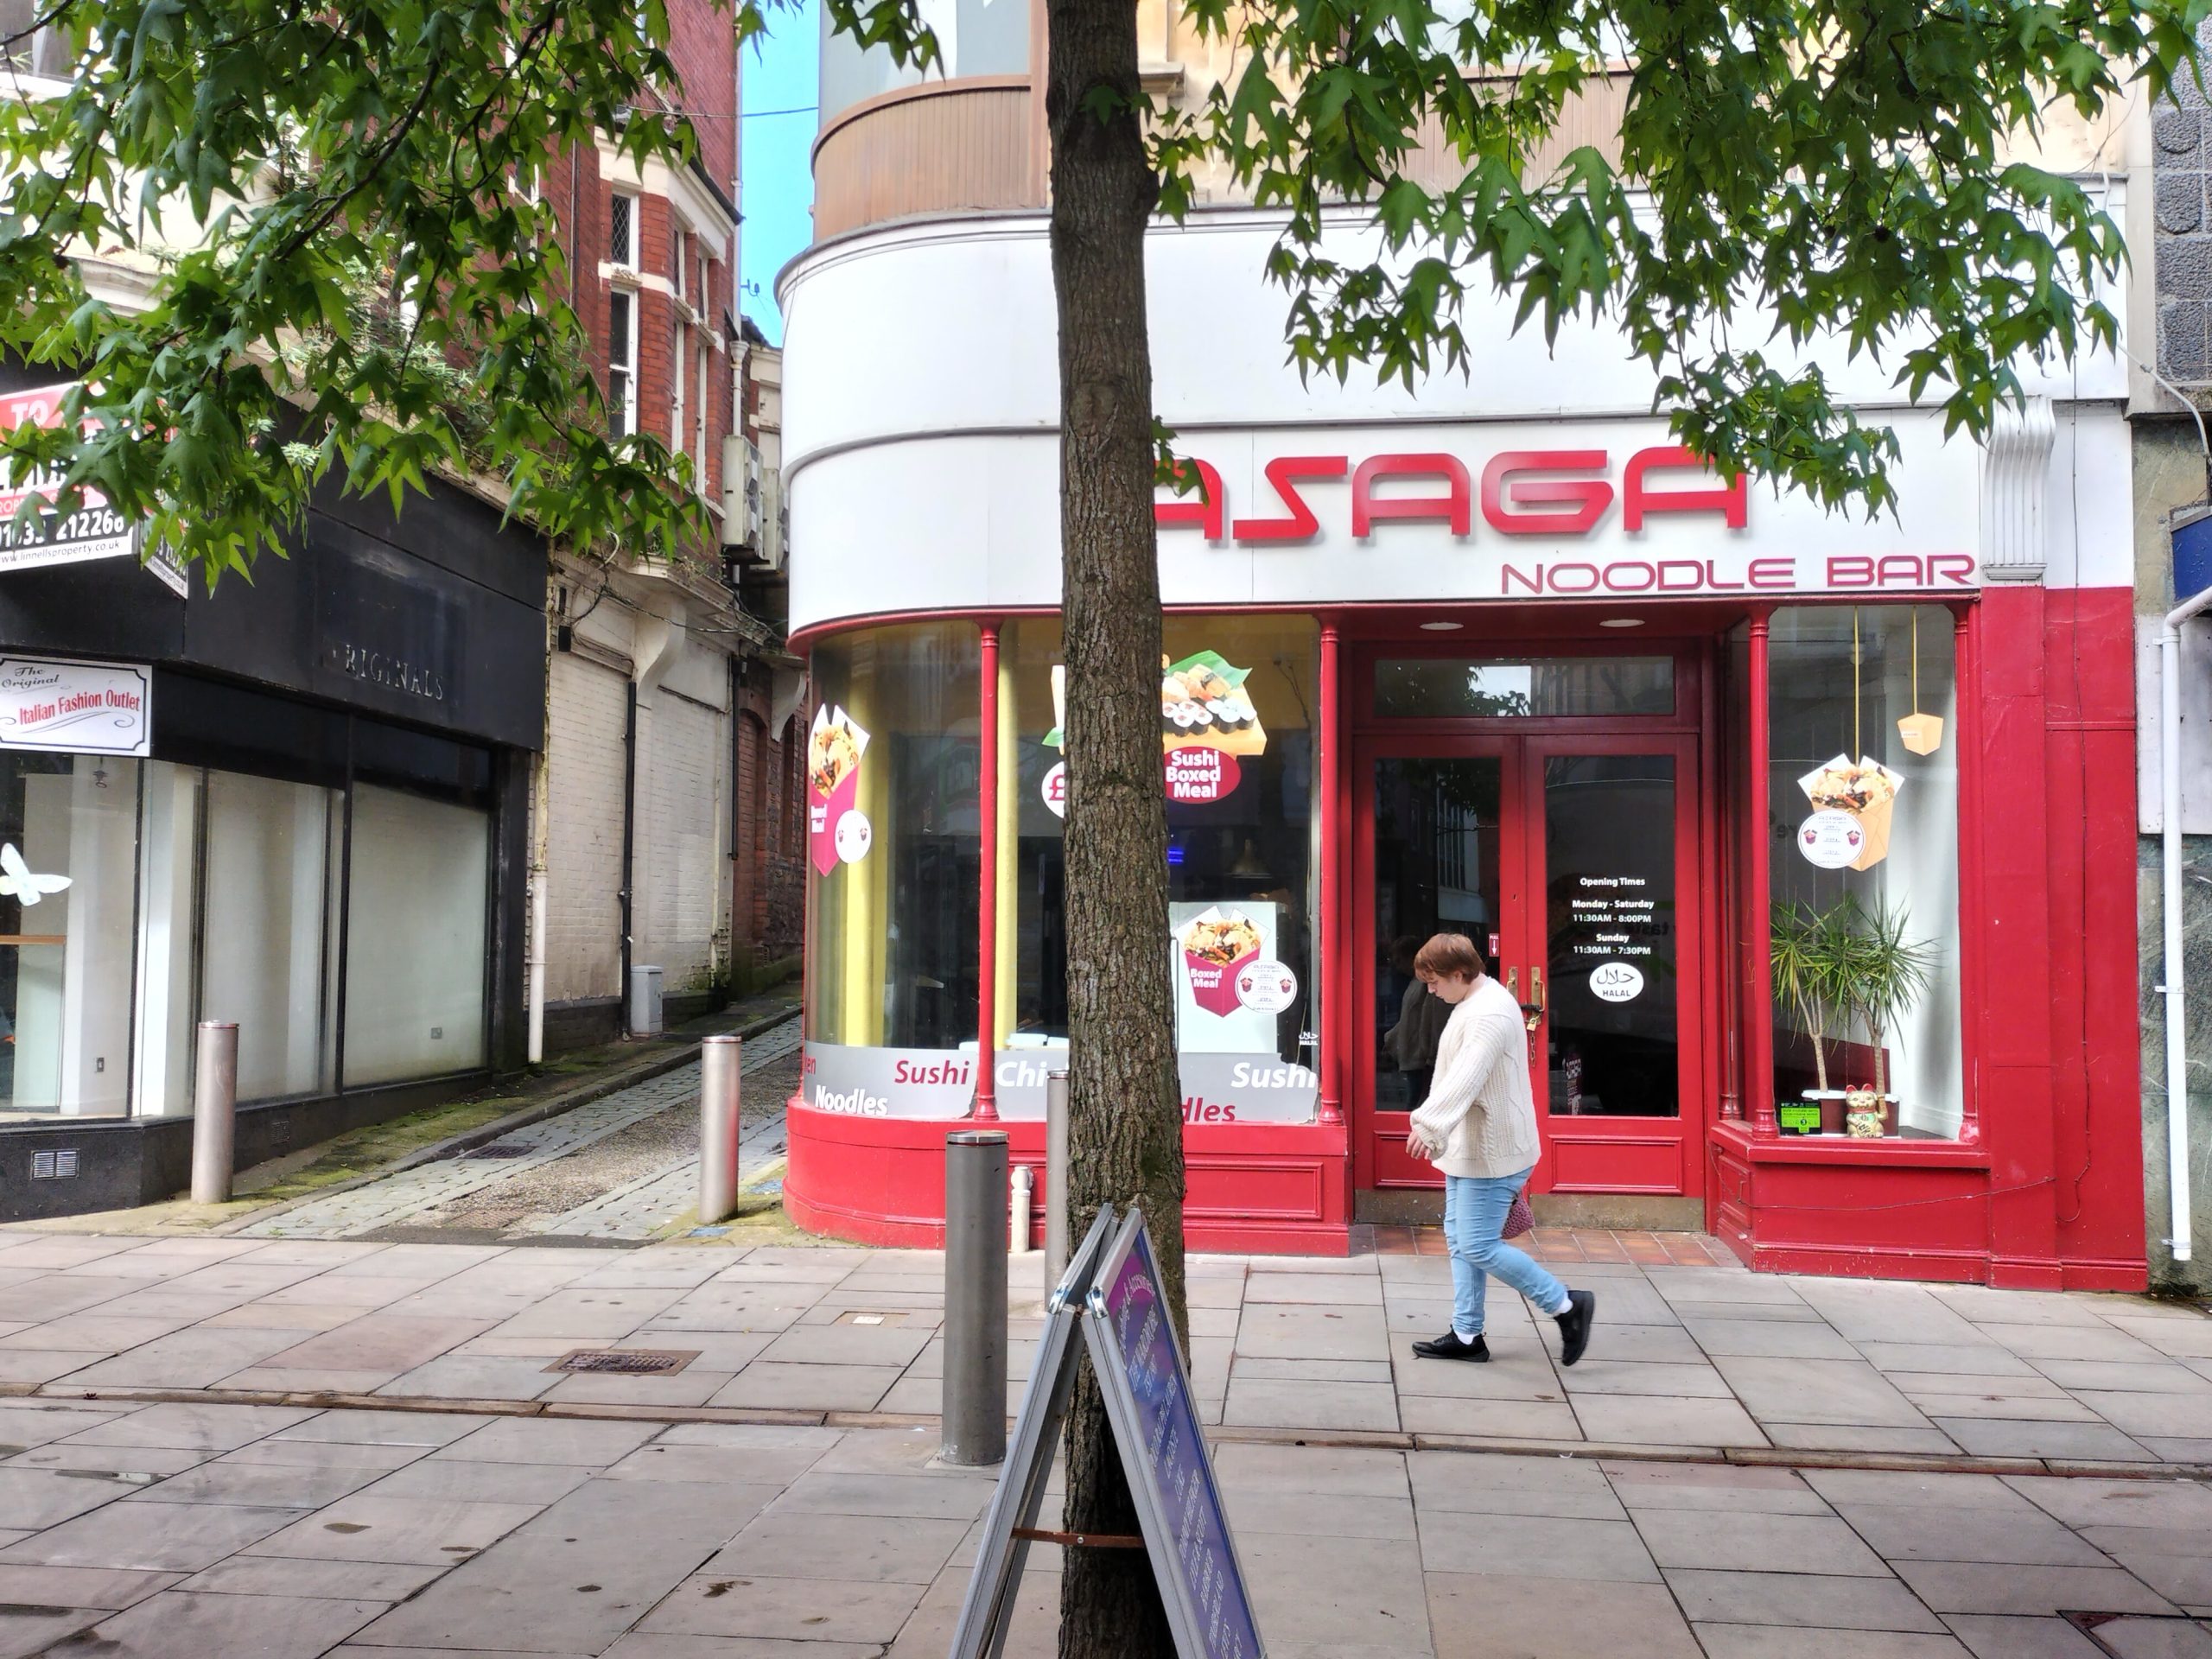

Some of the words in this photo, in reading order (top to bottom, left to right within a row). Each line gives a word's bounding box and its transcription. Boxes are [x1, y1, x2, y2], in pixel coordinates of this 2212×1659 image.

[0, 539, 120, 563] ww.linnellsproperty.co.uk
[1502, 558, 1796, 595] NOODLE
[1827, 555, 1975, 588] BAR
[14, 666, 44, 677] The
[333, 644, 444, 701] RIGINALS
[2, 674, 60, 689] Original
[20, 704, 55, 726] Italian
[58, 691, 102, 715] Fashion
[105, 689, 140, 712] Outlet
[1171, 750, 1219, 767] Sushi
[1166, 766, 1221, 783] Boxed
[1173, 782, 1217, 798] Meal
[1580, 877, 1618, 887] Opening
[1618, 877, 1646, 887] Times
[1572, 899, 1608, 910] Monday
[1614, 899, 1655, 910] Saturday
[1573, 914, 1611, 923] 11:30AM
[1618, 914, 1651, 923] 8:00PM
[1596, 933, 1630, 944] Sunday
[1573, 945, 1611, 954] 11:30AM
[1618, 946, 1651, 955] 7:30PM
[1190, 968, 1222, 979] Boxed
[1597, 969, 1635, 985] حلال
[1193, 978, 1218, 988] Meal
[895, 1060, 969, 1085] Sushi
[815, 1084, 888, 1116] Noodles
